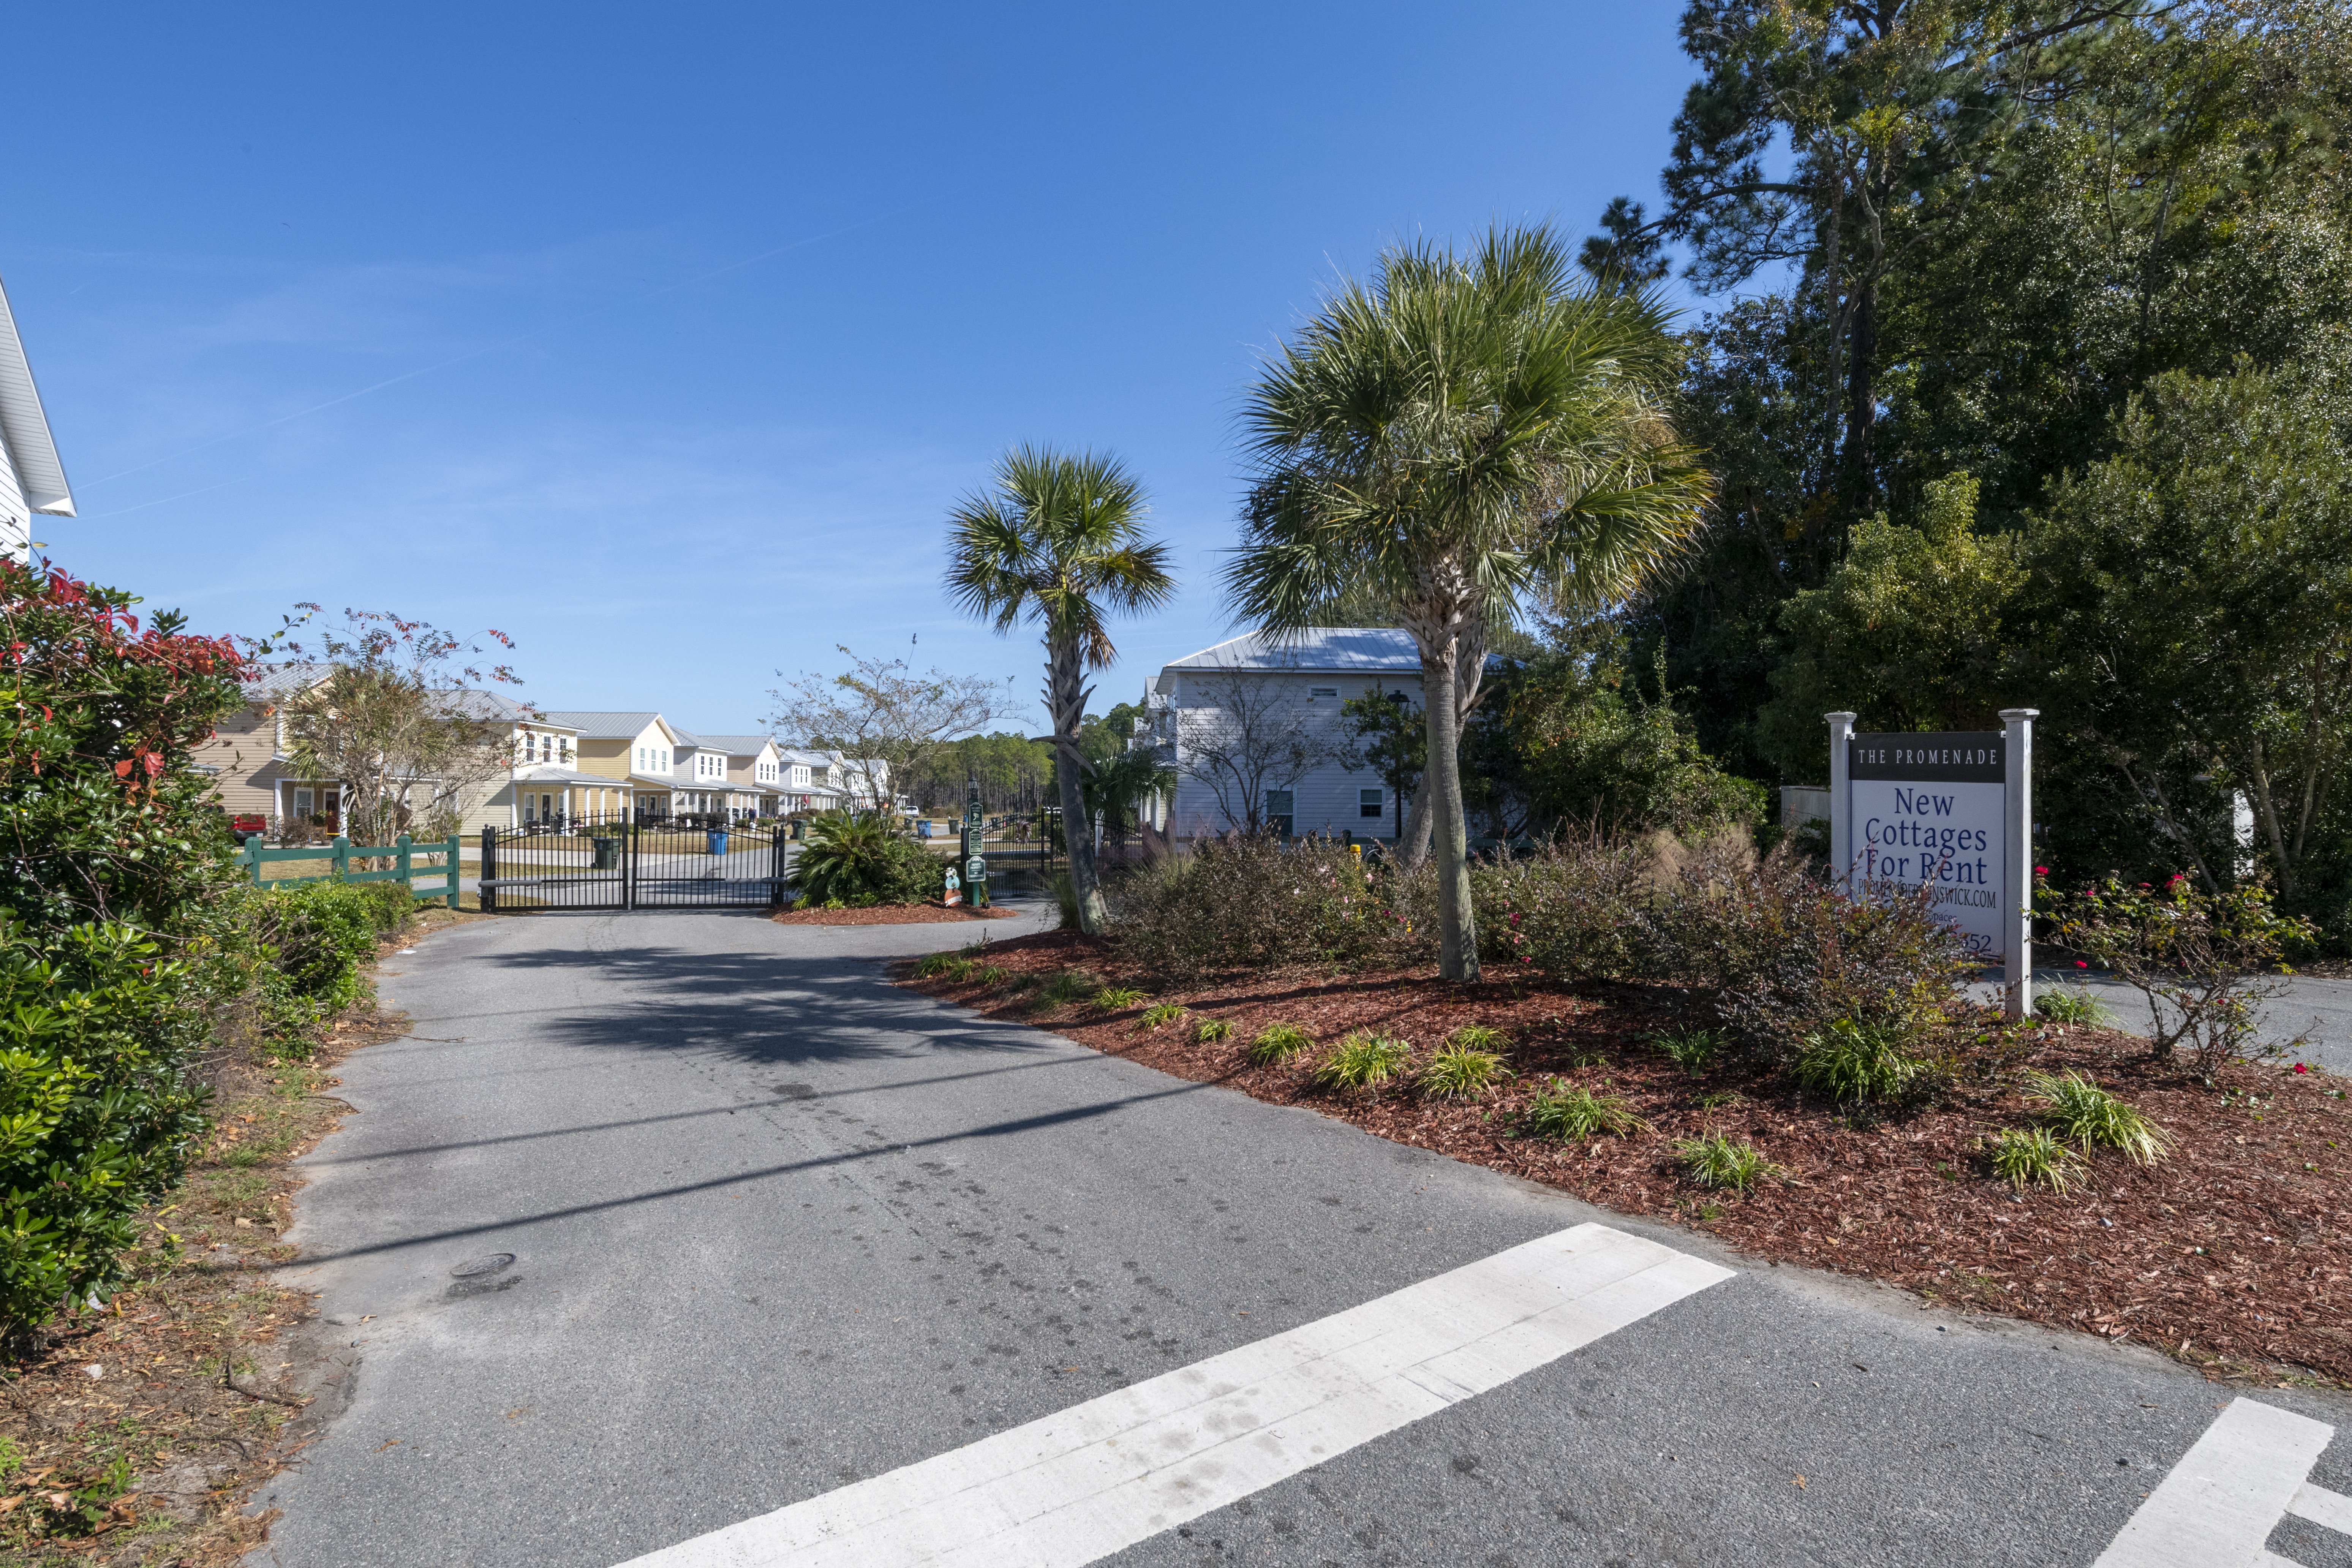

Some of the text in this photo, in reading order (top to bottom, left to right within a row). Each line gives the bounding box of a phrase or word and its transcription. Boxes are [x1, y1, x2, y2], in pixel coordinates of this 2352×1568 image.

[1859, 750, 1996, 764] THE PROMENADE
[1894, 788, 1955, 816] New
[1865, 818, 1987, 858] Cottages
[1866, 849, 1987, 885] For Rent
